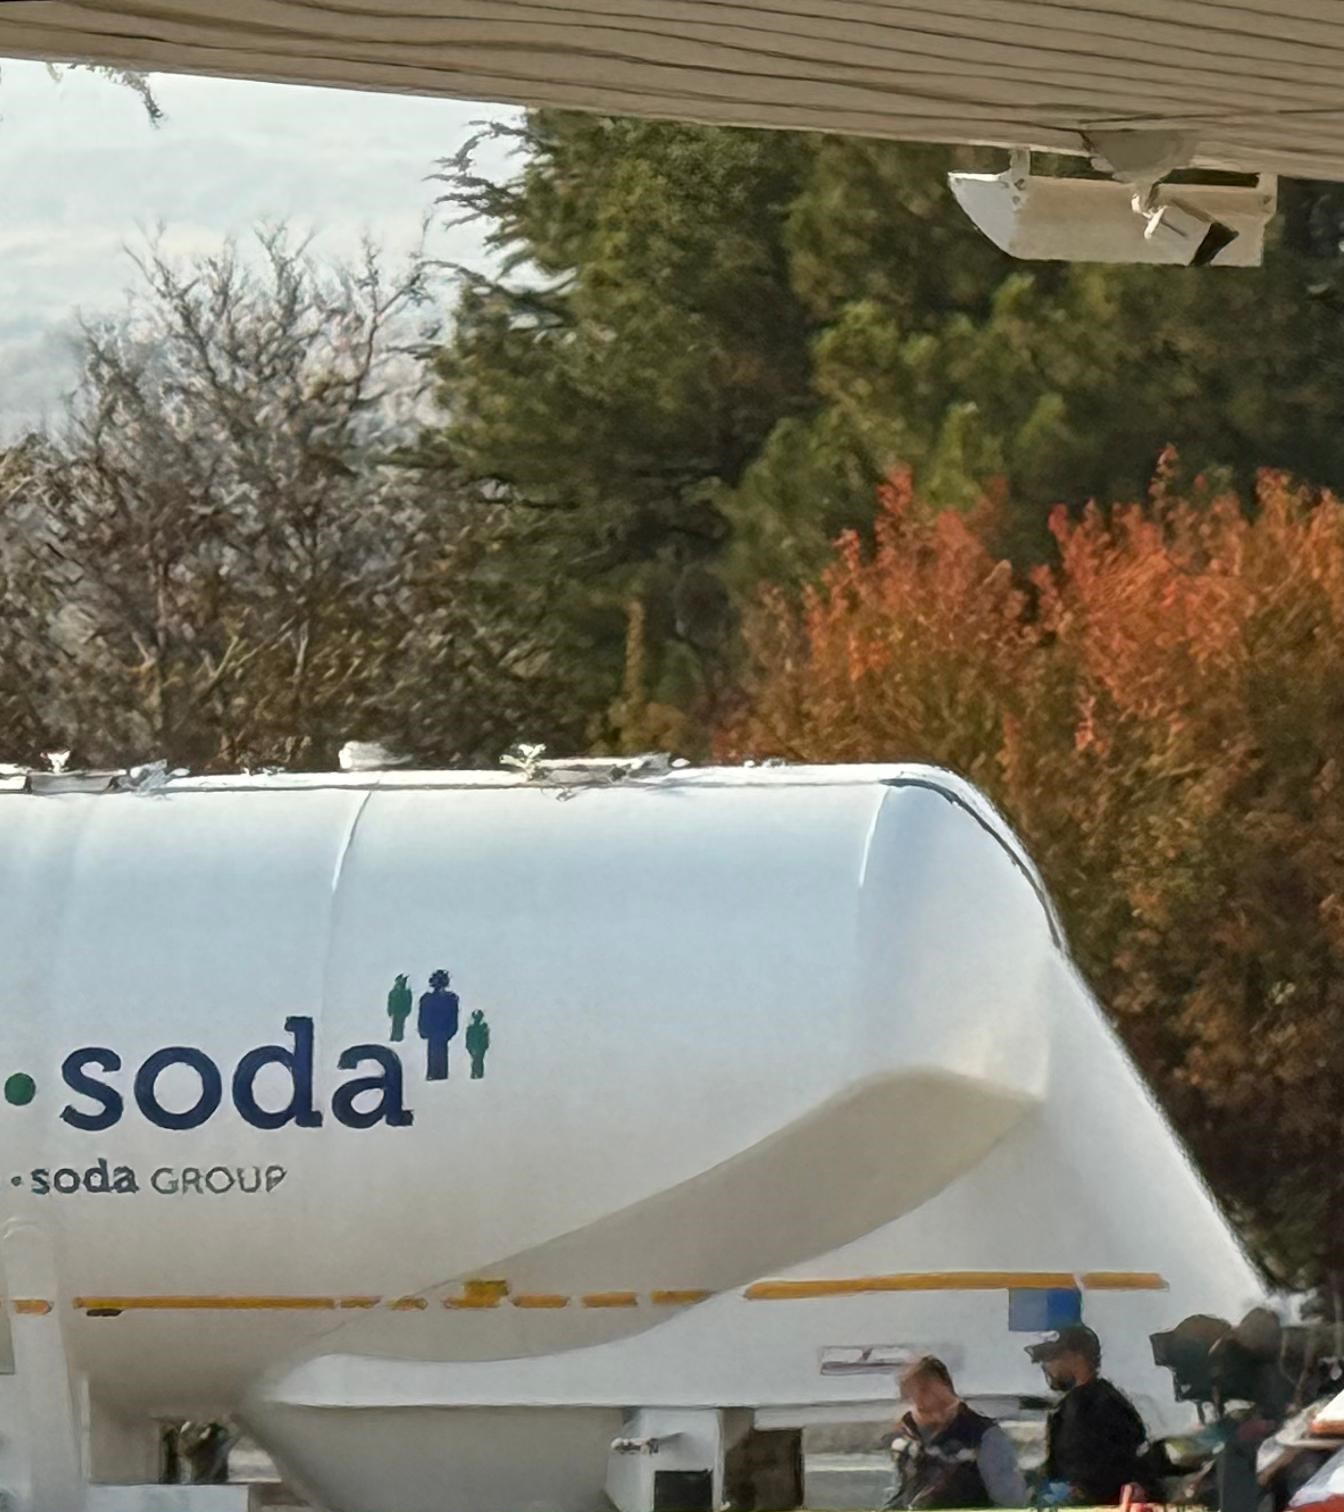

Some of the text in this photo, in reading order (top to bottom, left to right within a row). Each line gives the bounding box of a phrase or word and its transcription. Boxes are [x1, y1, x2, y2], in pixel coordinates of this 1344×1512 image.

[58, 1015, 415, 1132] soda
[30, 1157, 141, 1196] soda
[150, 1165, 288, 1195] GROUP
